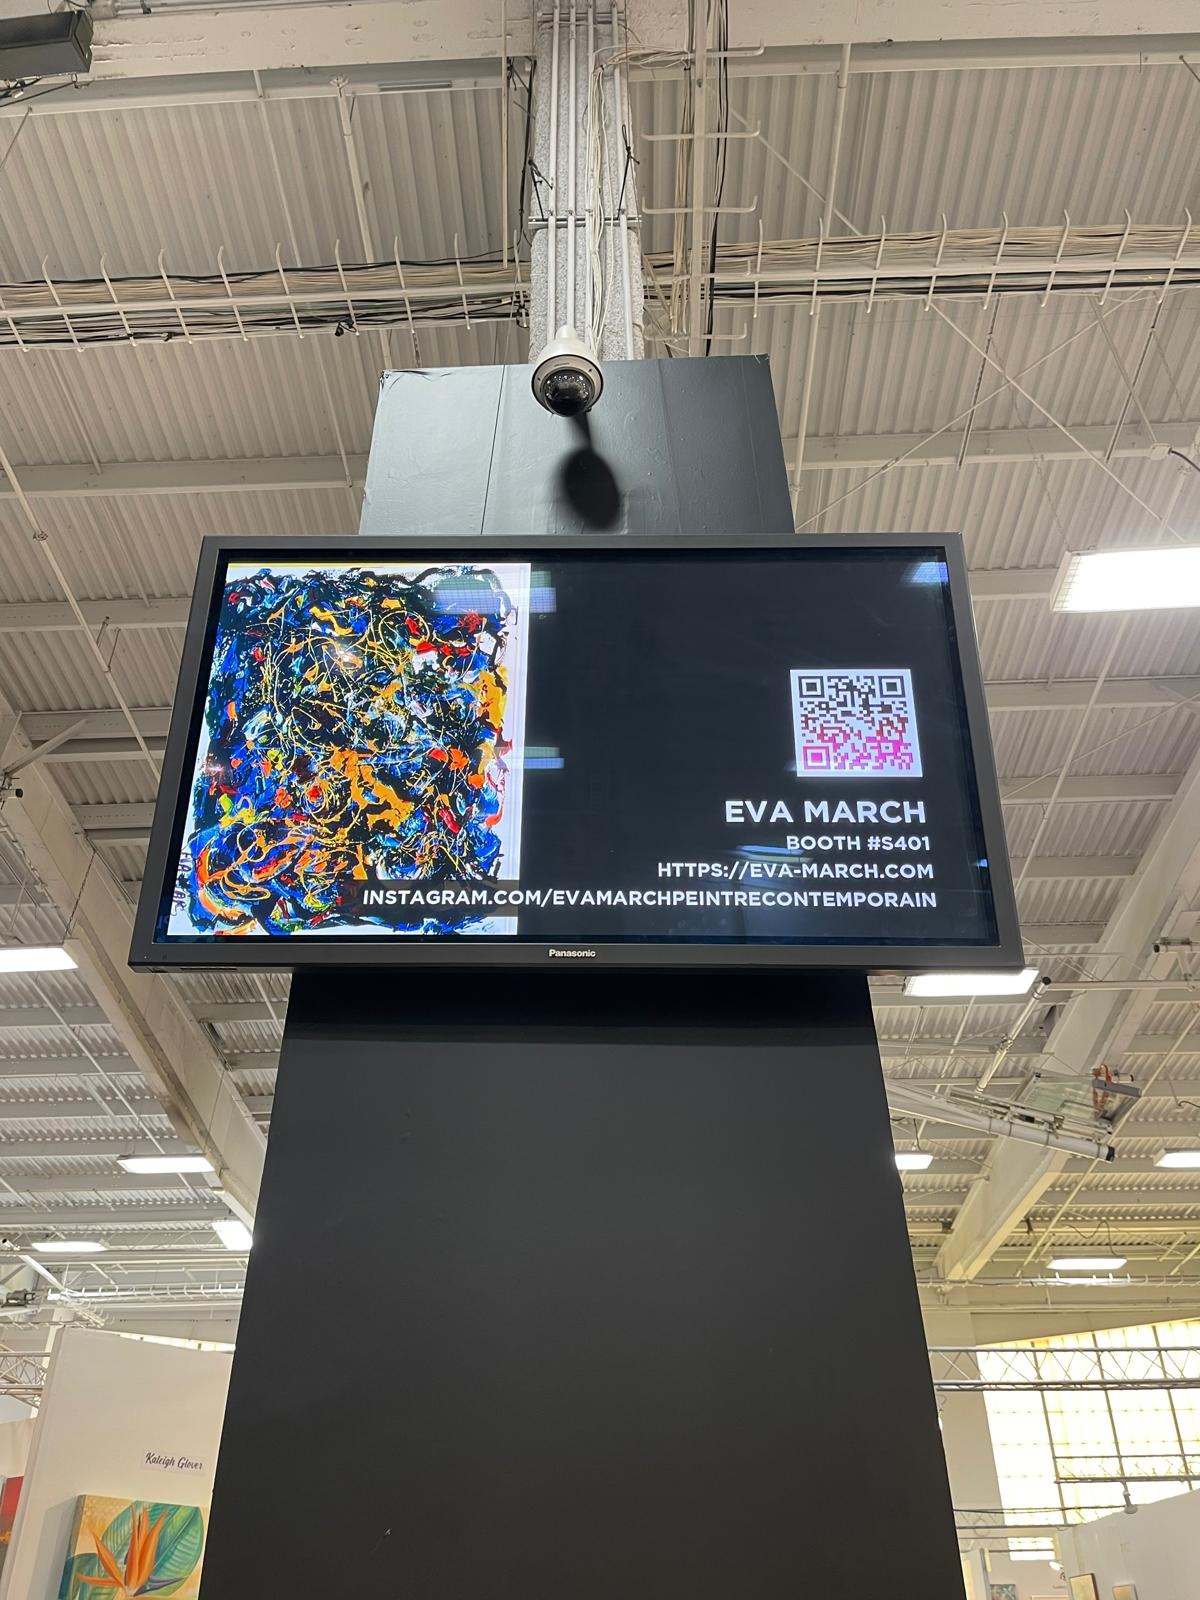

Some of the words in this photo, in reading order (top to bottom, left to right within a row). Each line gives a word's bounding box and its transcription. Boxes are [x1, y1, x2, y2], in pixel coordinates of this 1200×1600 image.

[725, 800, 794, 823] EVA
[803, 800, 926, 824] MARCH
[786, 835, 861, 850] BOOTH
[867, 836, 931, 851] #S401
[657, 861, 934, 880] HTTPS://EVA-MARCH.COM
[362, 889, 937, 908] INSTAGRAM.COM/EVAMARCHPEINTRECONTEMPORAIN
[548, 948, 596, 959] Panasonic
[145, 1452, 176, 1469] Kaleigh
[177, 1456, 203, 1471] Glover
